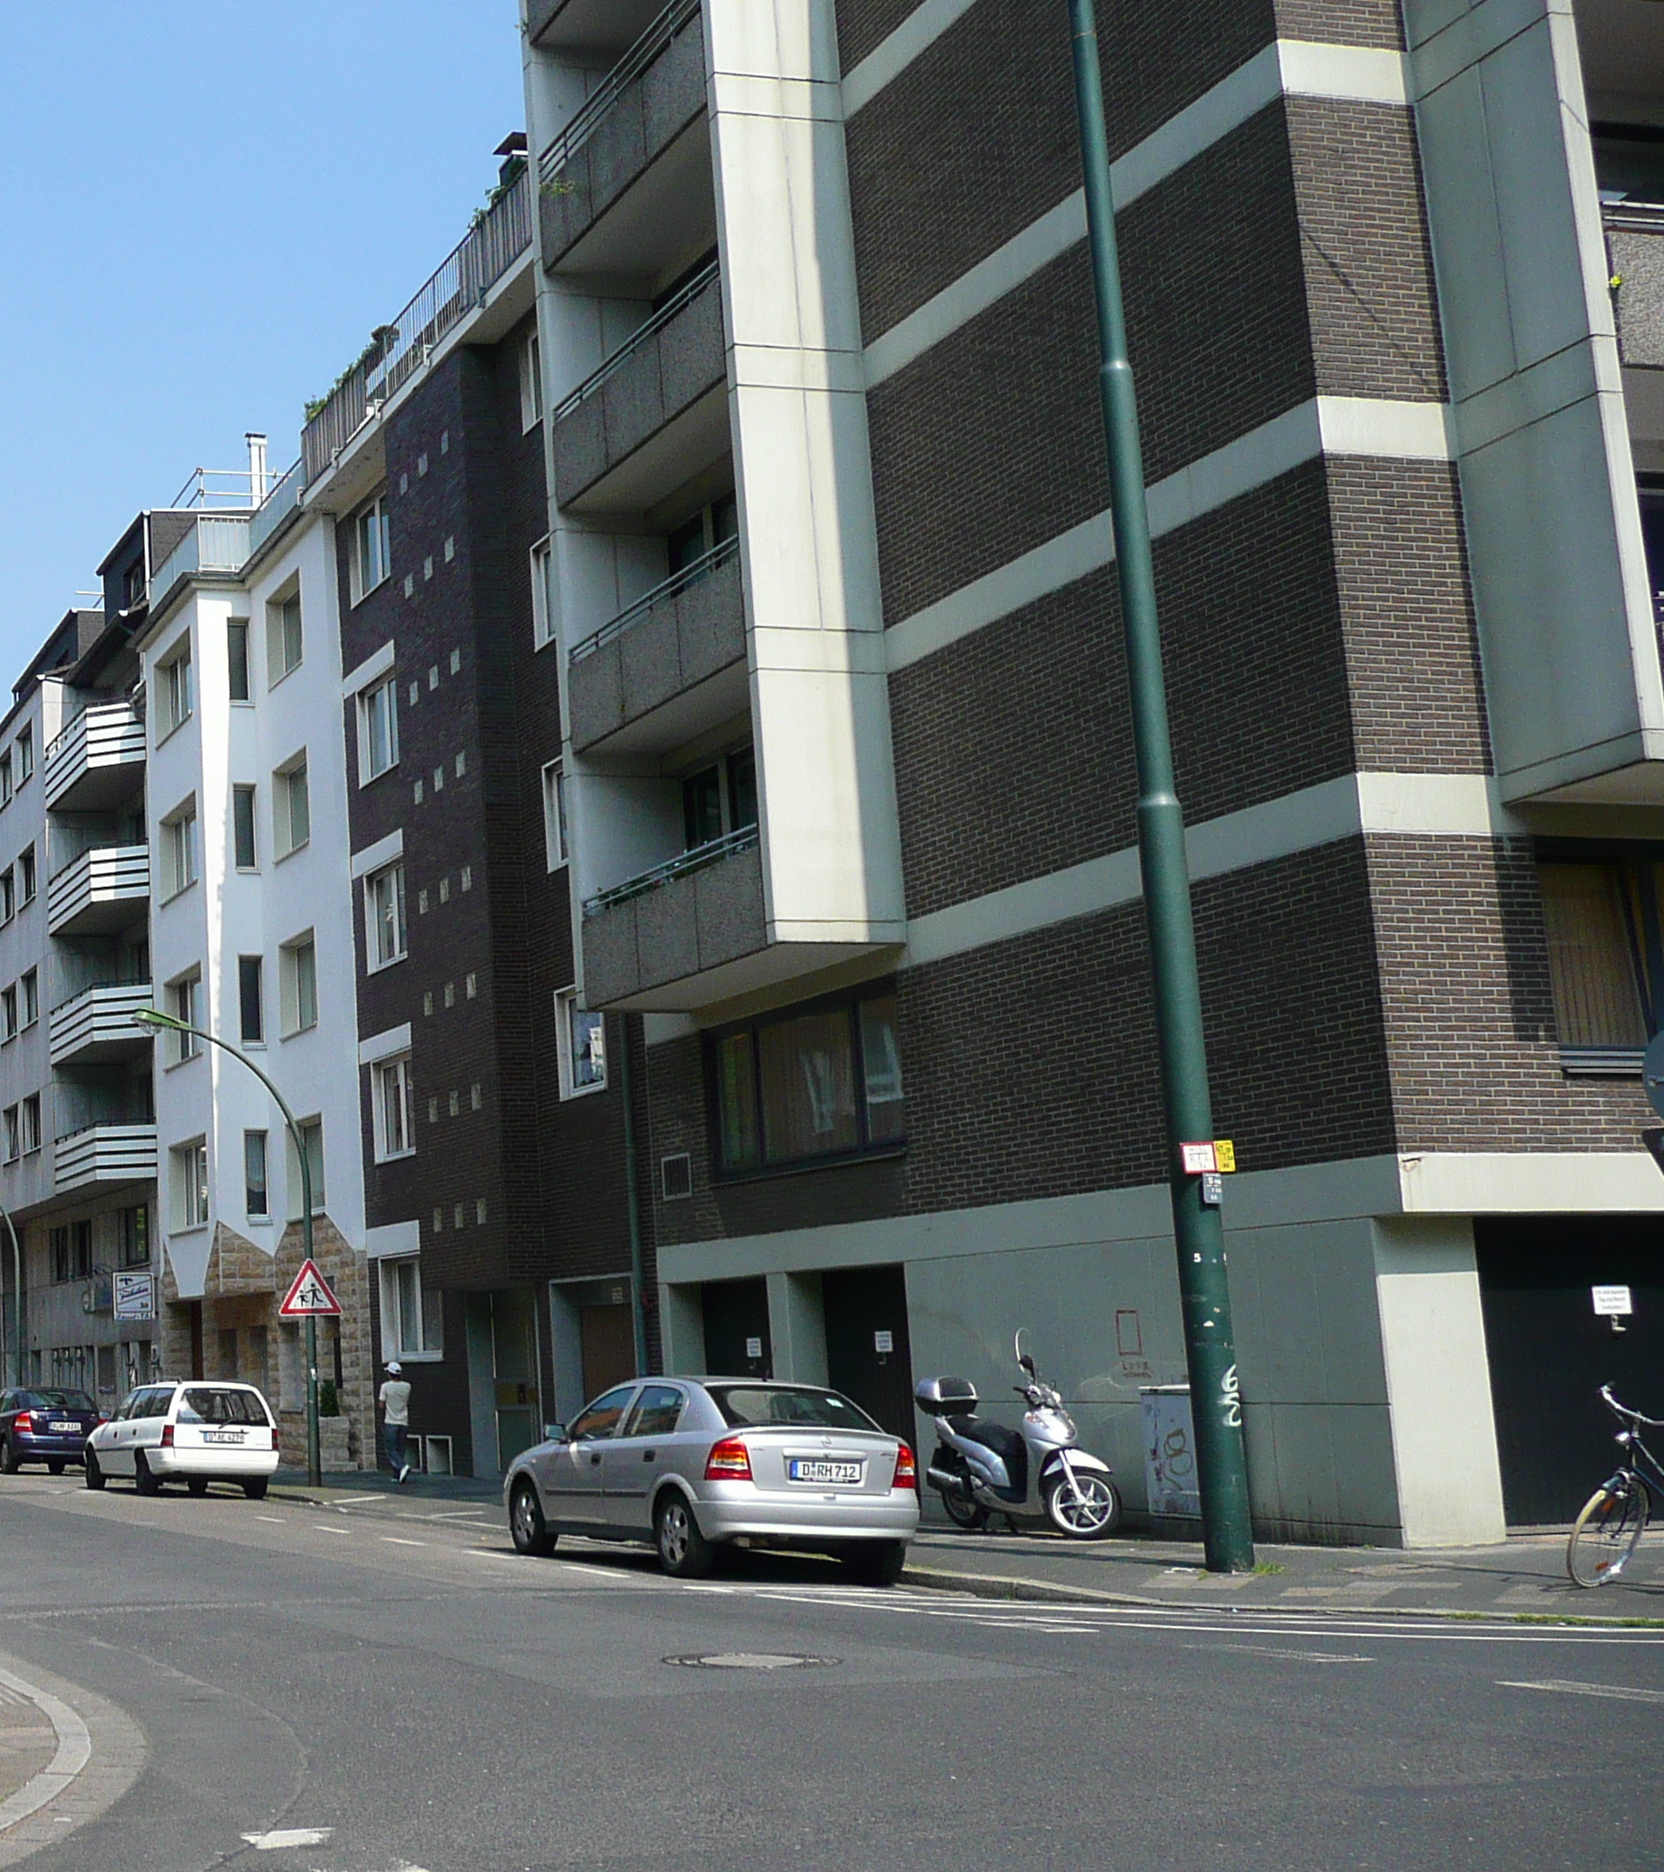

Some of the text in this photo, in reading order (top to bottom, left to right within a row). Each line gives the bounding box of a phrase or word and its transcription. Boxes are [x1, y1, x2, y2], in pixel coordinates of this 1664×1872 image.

[802, 1463, 856, 1479] D RH 712
